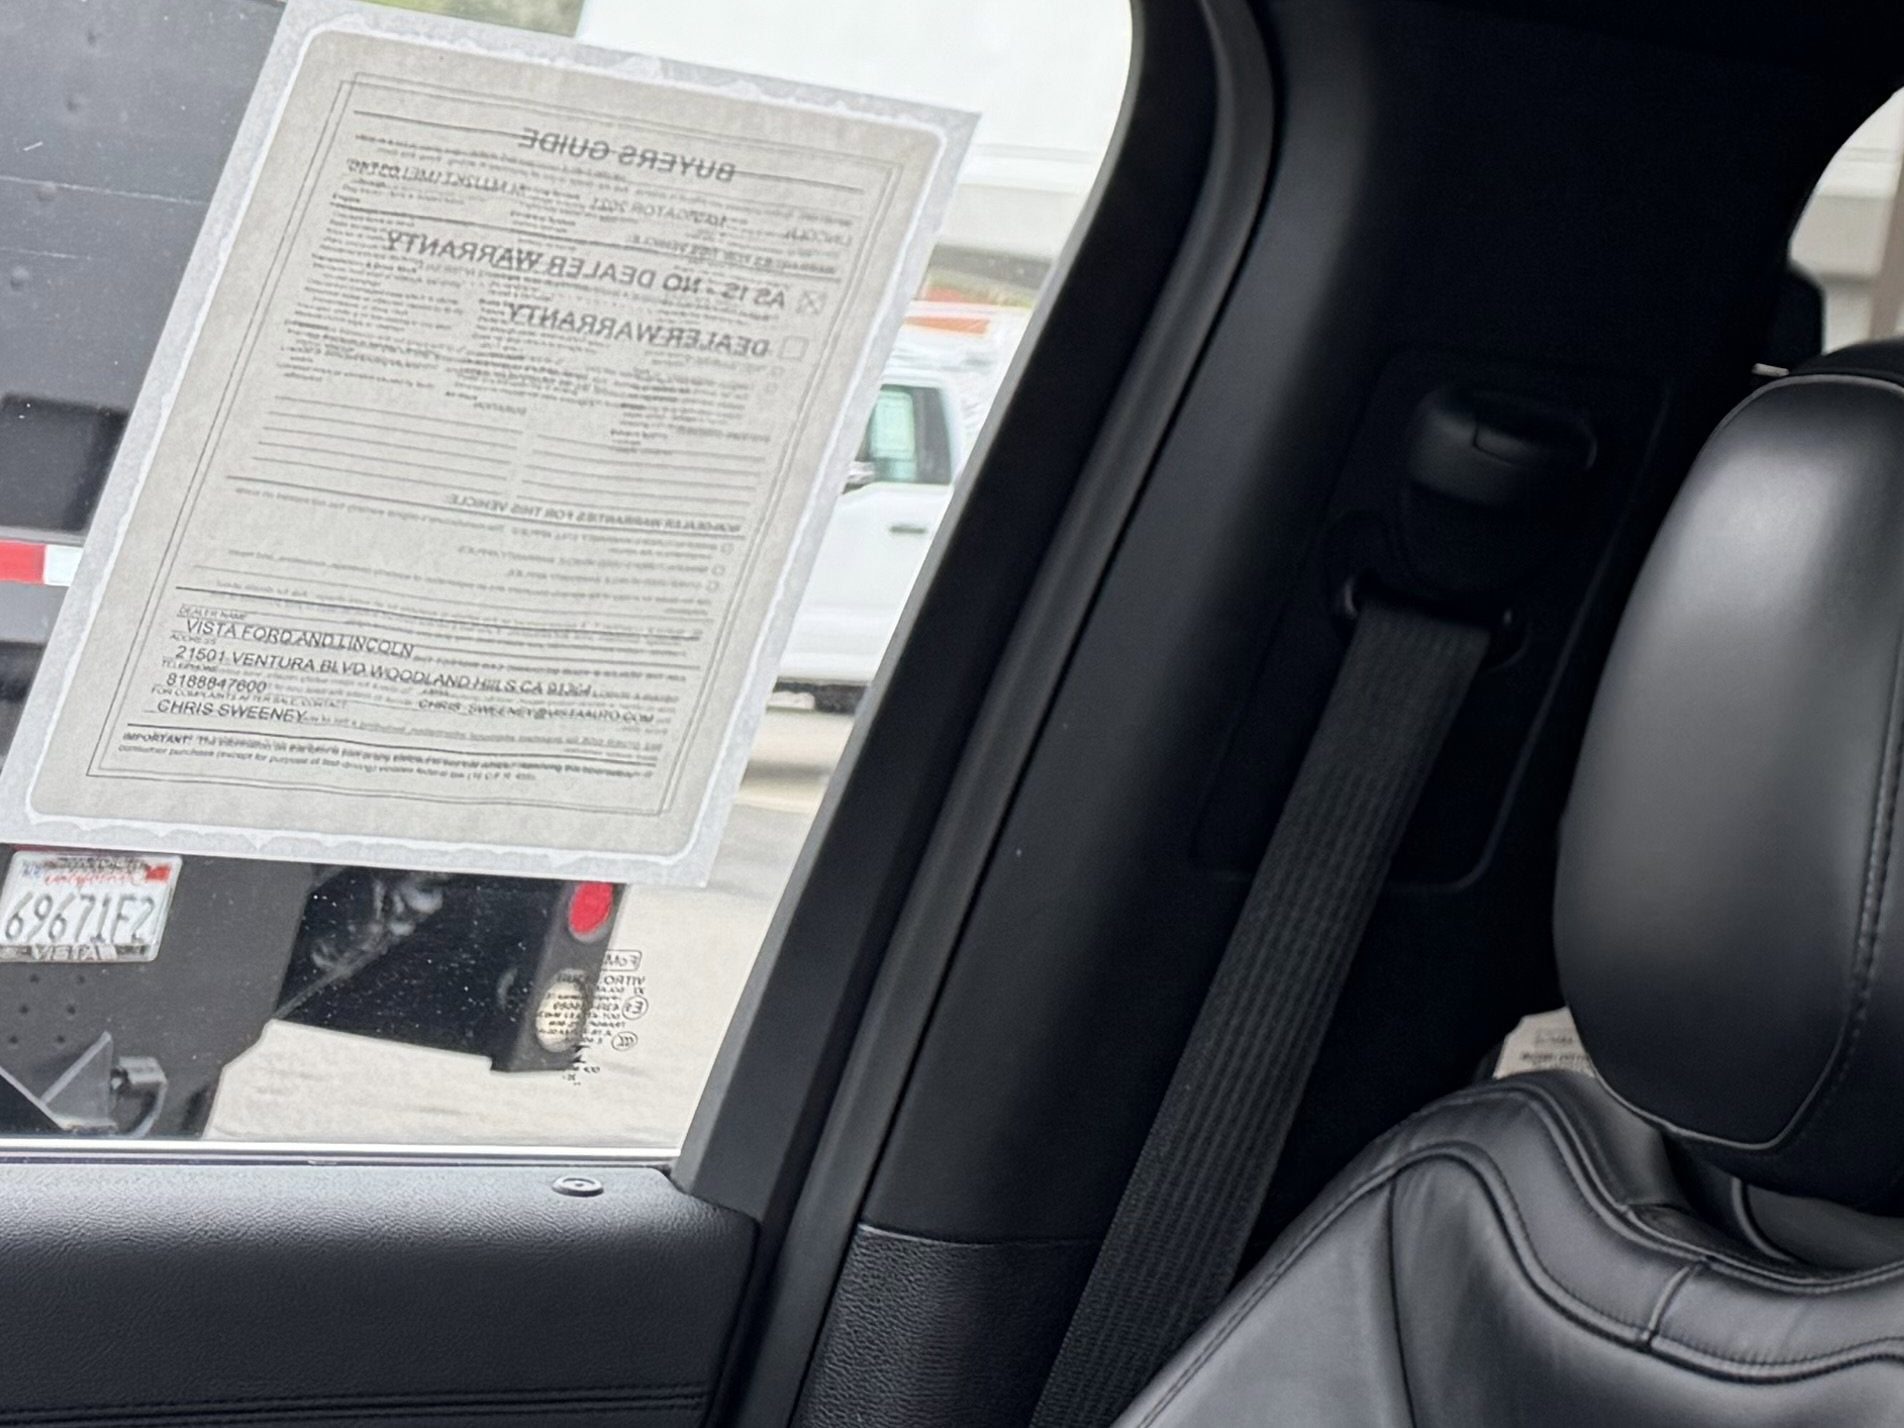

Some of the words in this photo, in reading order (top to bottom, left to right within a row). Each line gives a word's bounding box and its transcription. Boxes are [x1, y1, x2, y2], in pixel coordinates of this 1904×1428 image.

[187, 618, 237, 637] VISTA
[241, 624, 294, 644] FORD
[297, 631, 335, 648] AND
[337, 633, 416, 660] LINCOLN
[175, 645, 227, 663] 21501
[232, 651, 316, 672] VENTURA
[319, 659, 366, 677] BLVD
[370, 663, 472, 690] WOODLAND
[157, 699, 213, 717] CHRIS
[218, 704, 308, 724] SWEENEY
[5, 892, 156, 943] 69671F2
